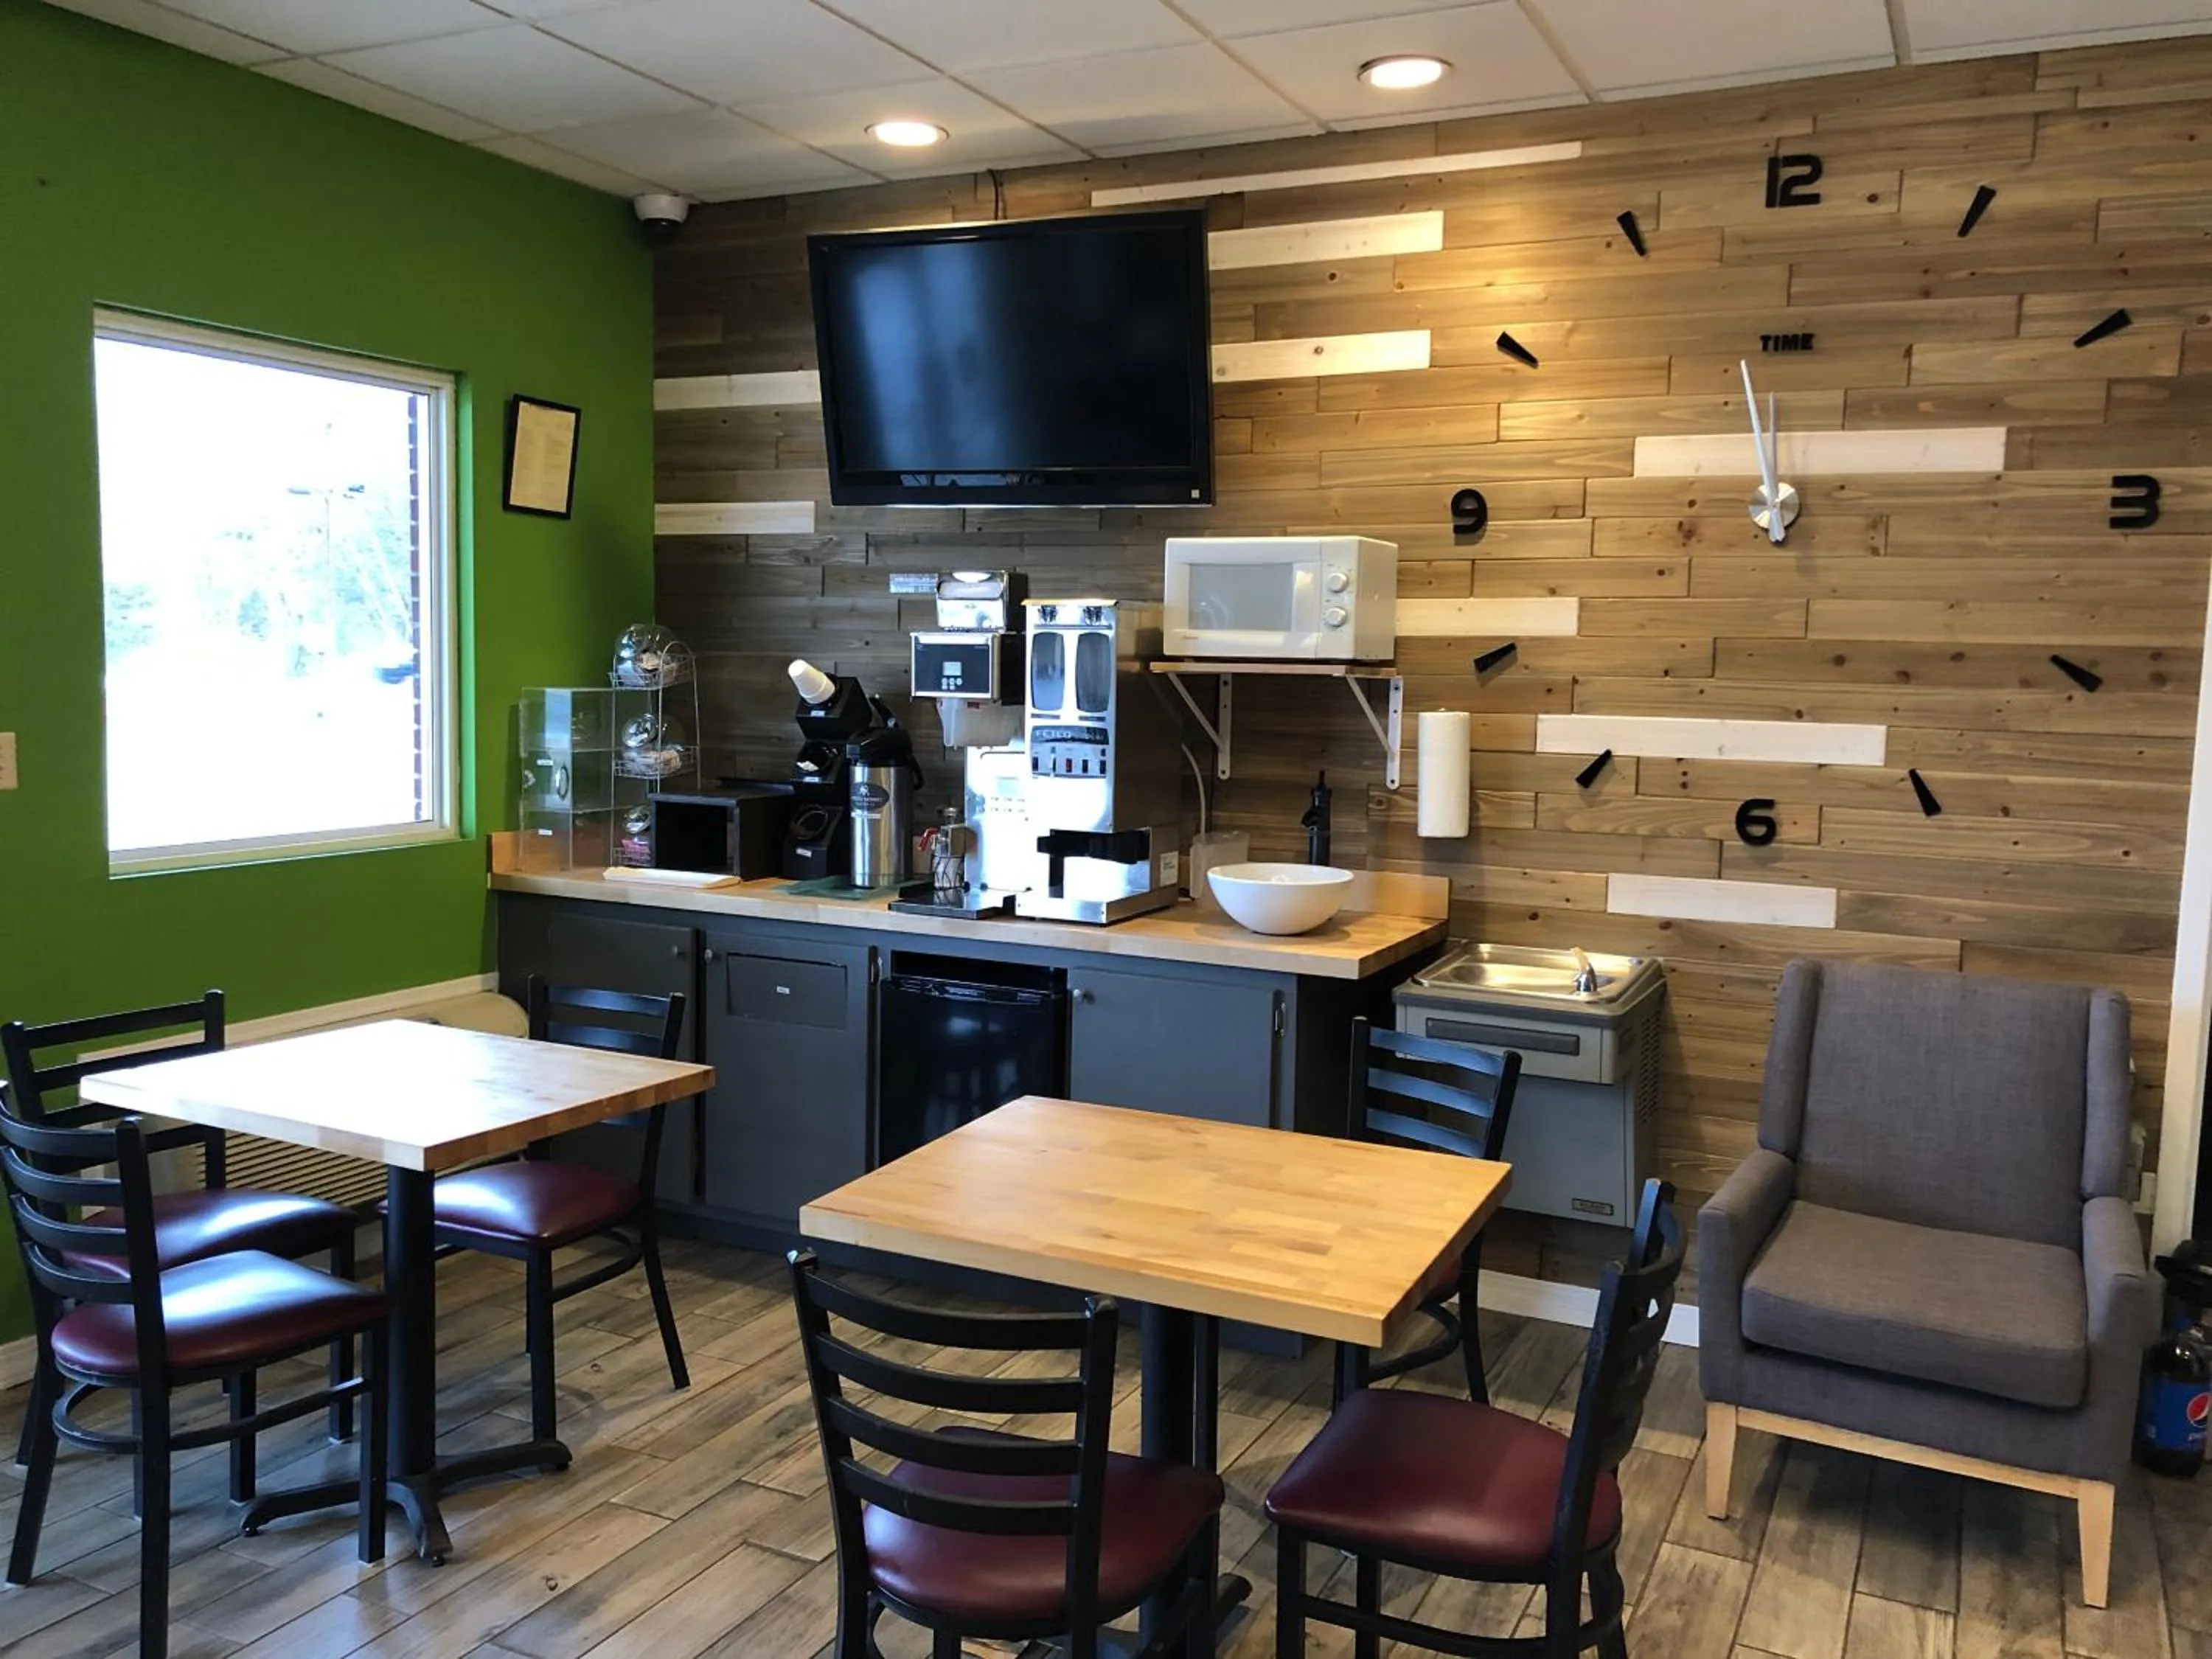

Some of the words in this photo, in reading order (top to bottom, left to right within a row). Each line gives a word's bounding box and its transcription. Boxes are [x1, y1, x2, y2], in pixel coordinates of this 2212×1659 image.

[1765, 154, 1823, 208] 12
[1760, 333, 1815, 352] TIME
[1450, 488, 1488, 534] 9
[2109, 474, 2160, 529] 3
[1735, 798, 1777, 847] 6
